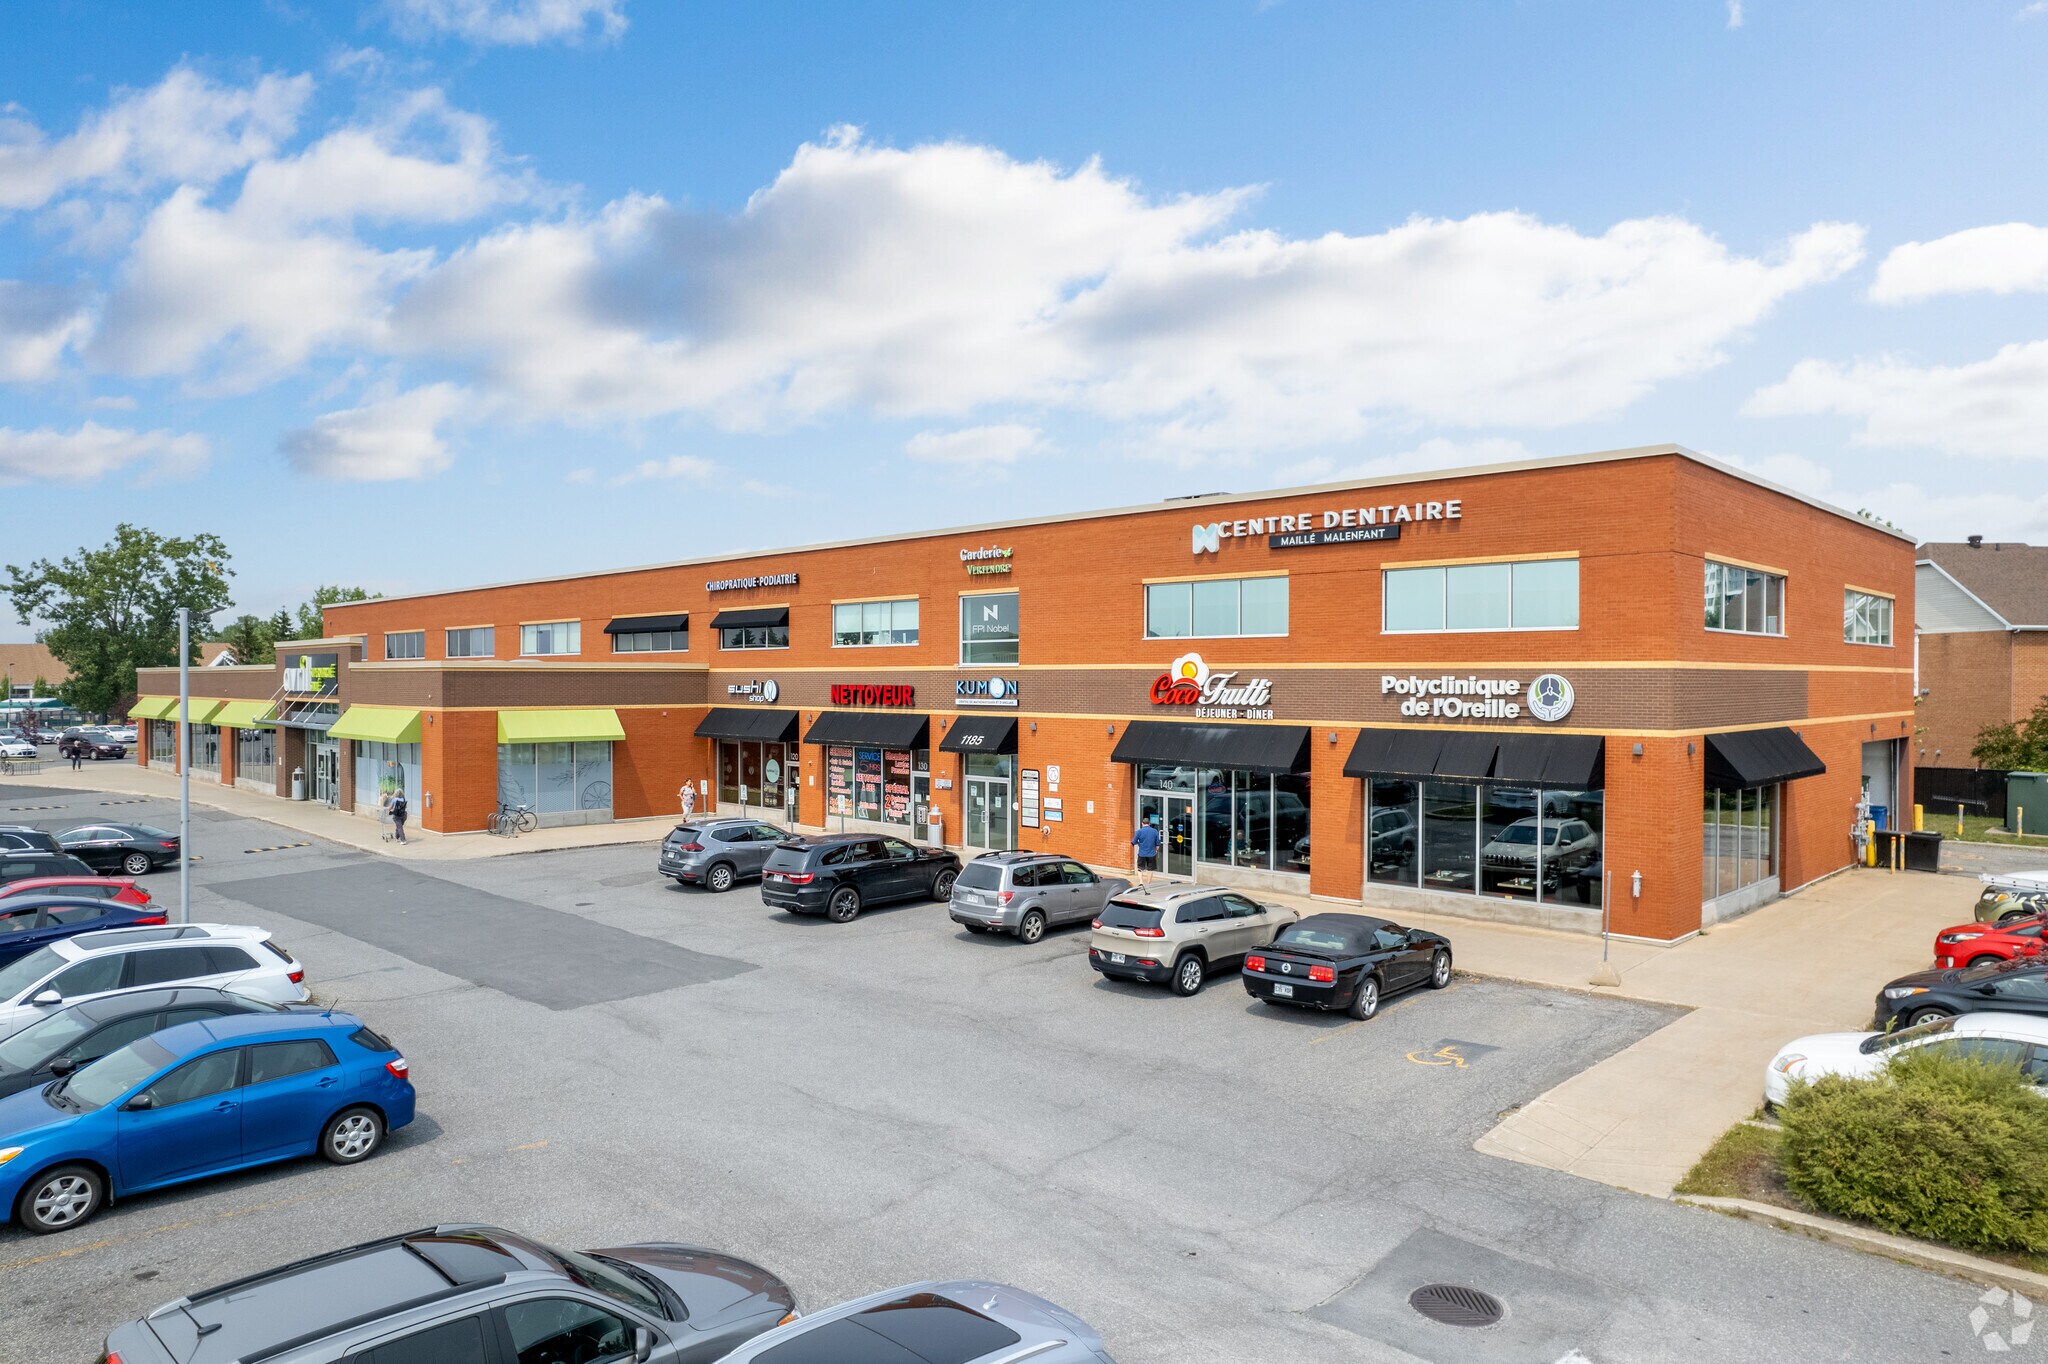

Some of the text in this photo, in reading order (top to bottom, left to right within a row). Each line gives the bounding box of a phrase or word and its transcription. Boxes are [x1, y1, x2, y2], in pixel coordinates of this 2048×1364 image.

[1217, 500, 1462, 537] CENTRE DENTAIRE
[1281, 529, 1386, 546] MAILLÉ MALENFANT
[960, 545, 1003, 561] Garderie
[986, 624, 1010, 633] Nobel
[728, 680, 762, 694] sushi
[956, 677, 1018, 698] KUMON
[1150, 671, 1273, 705] Coco Frutti
[1381, 675, 1521, 698] Polyclinique
[749, 695, 765, 703] shop
[831, 684, 913, 706] NETTOYEUR
[1196, 707, 1237, 718] DÉJEUNER
[1247, 708, 1274, 719] DÎNER
[1401, 697, 1520, 718] de l'Oreille
[961, 735, 985, 745] 1185
[859, 752, 880, 761] SERVICE
[917, 762, 928, 770] 130
[1160, 780, 1173, 789] 140
